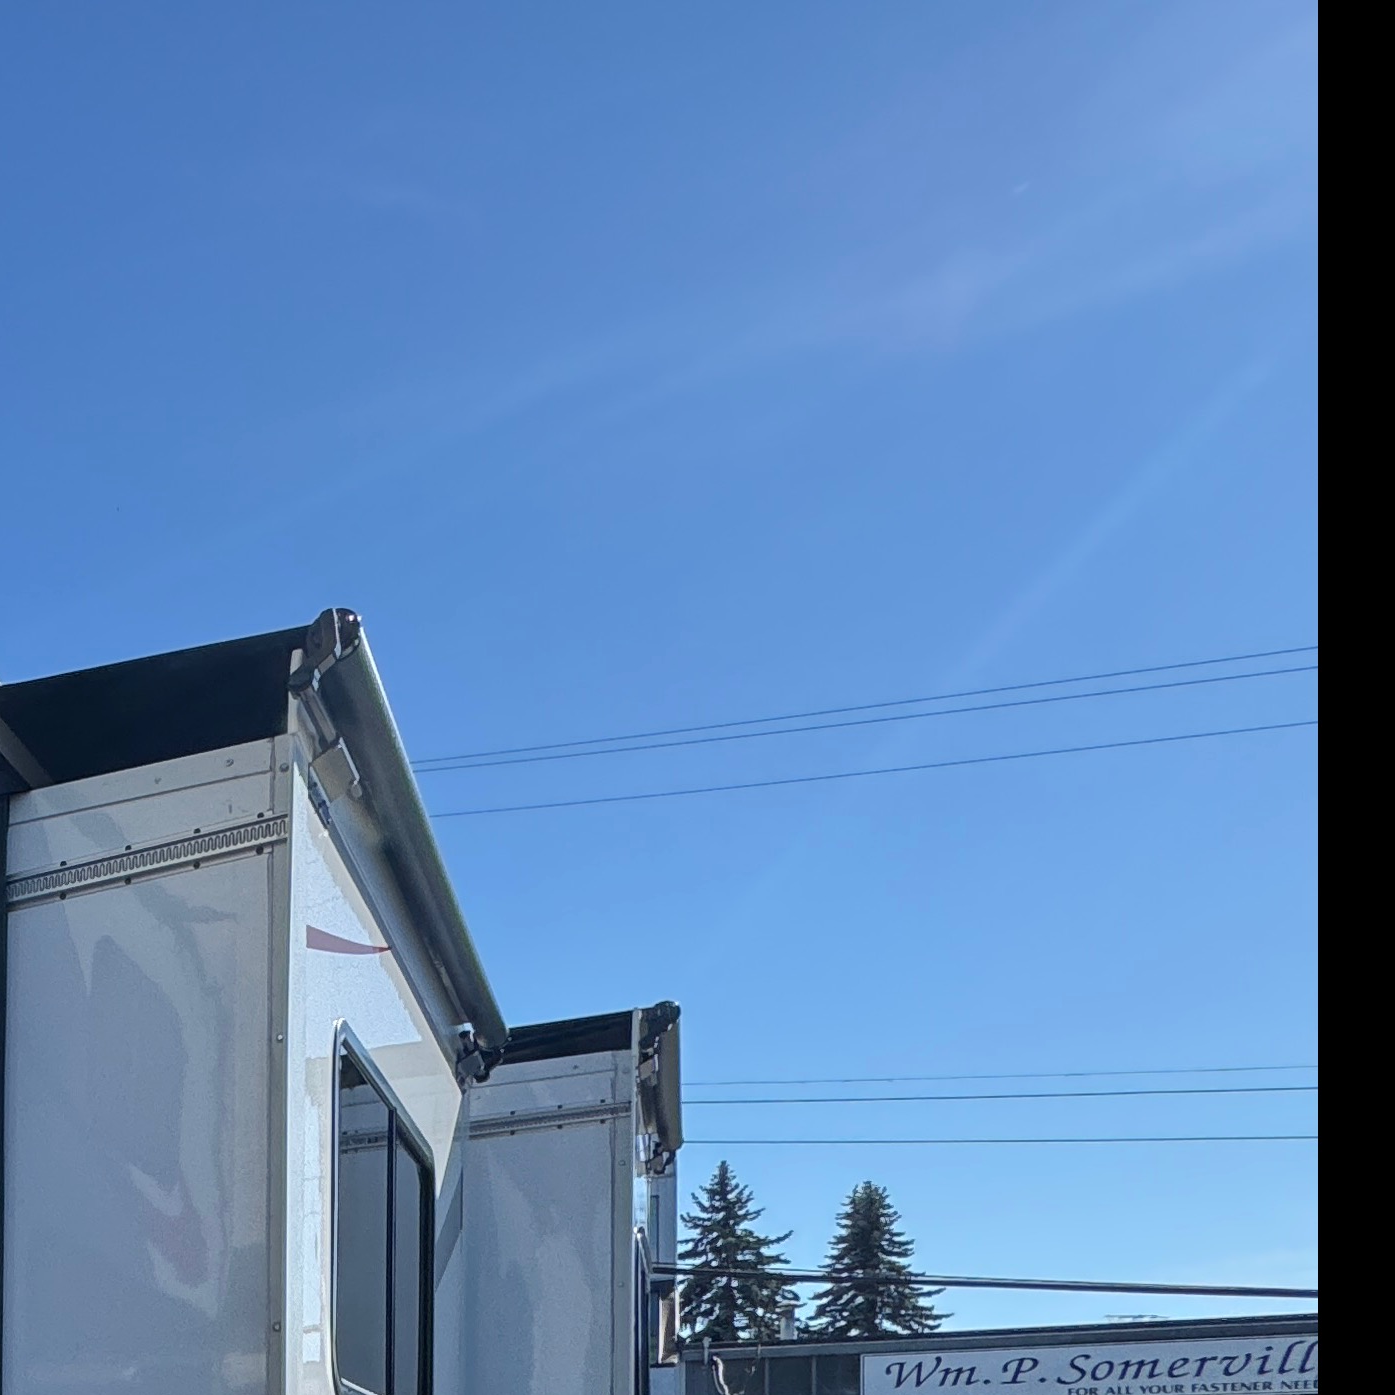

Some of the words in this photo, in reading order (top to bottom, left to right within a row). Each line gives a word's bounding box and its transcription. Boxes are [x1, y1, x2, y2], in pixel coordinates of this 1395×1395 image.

[885, 1356, 992, 1389] Wm.
[1000, 1357, 1047, 1385] P.
[1056, 1339, 1318, 1386] Somervill
[1105, 1385, 1133, 1395] ALL
[1139, 1384, 1185, 1395] YOUR
[1191, 1381, 1272, 1393] FASTENER
